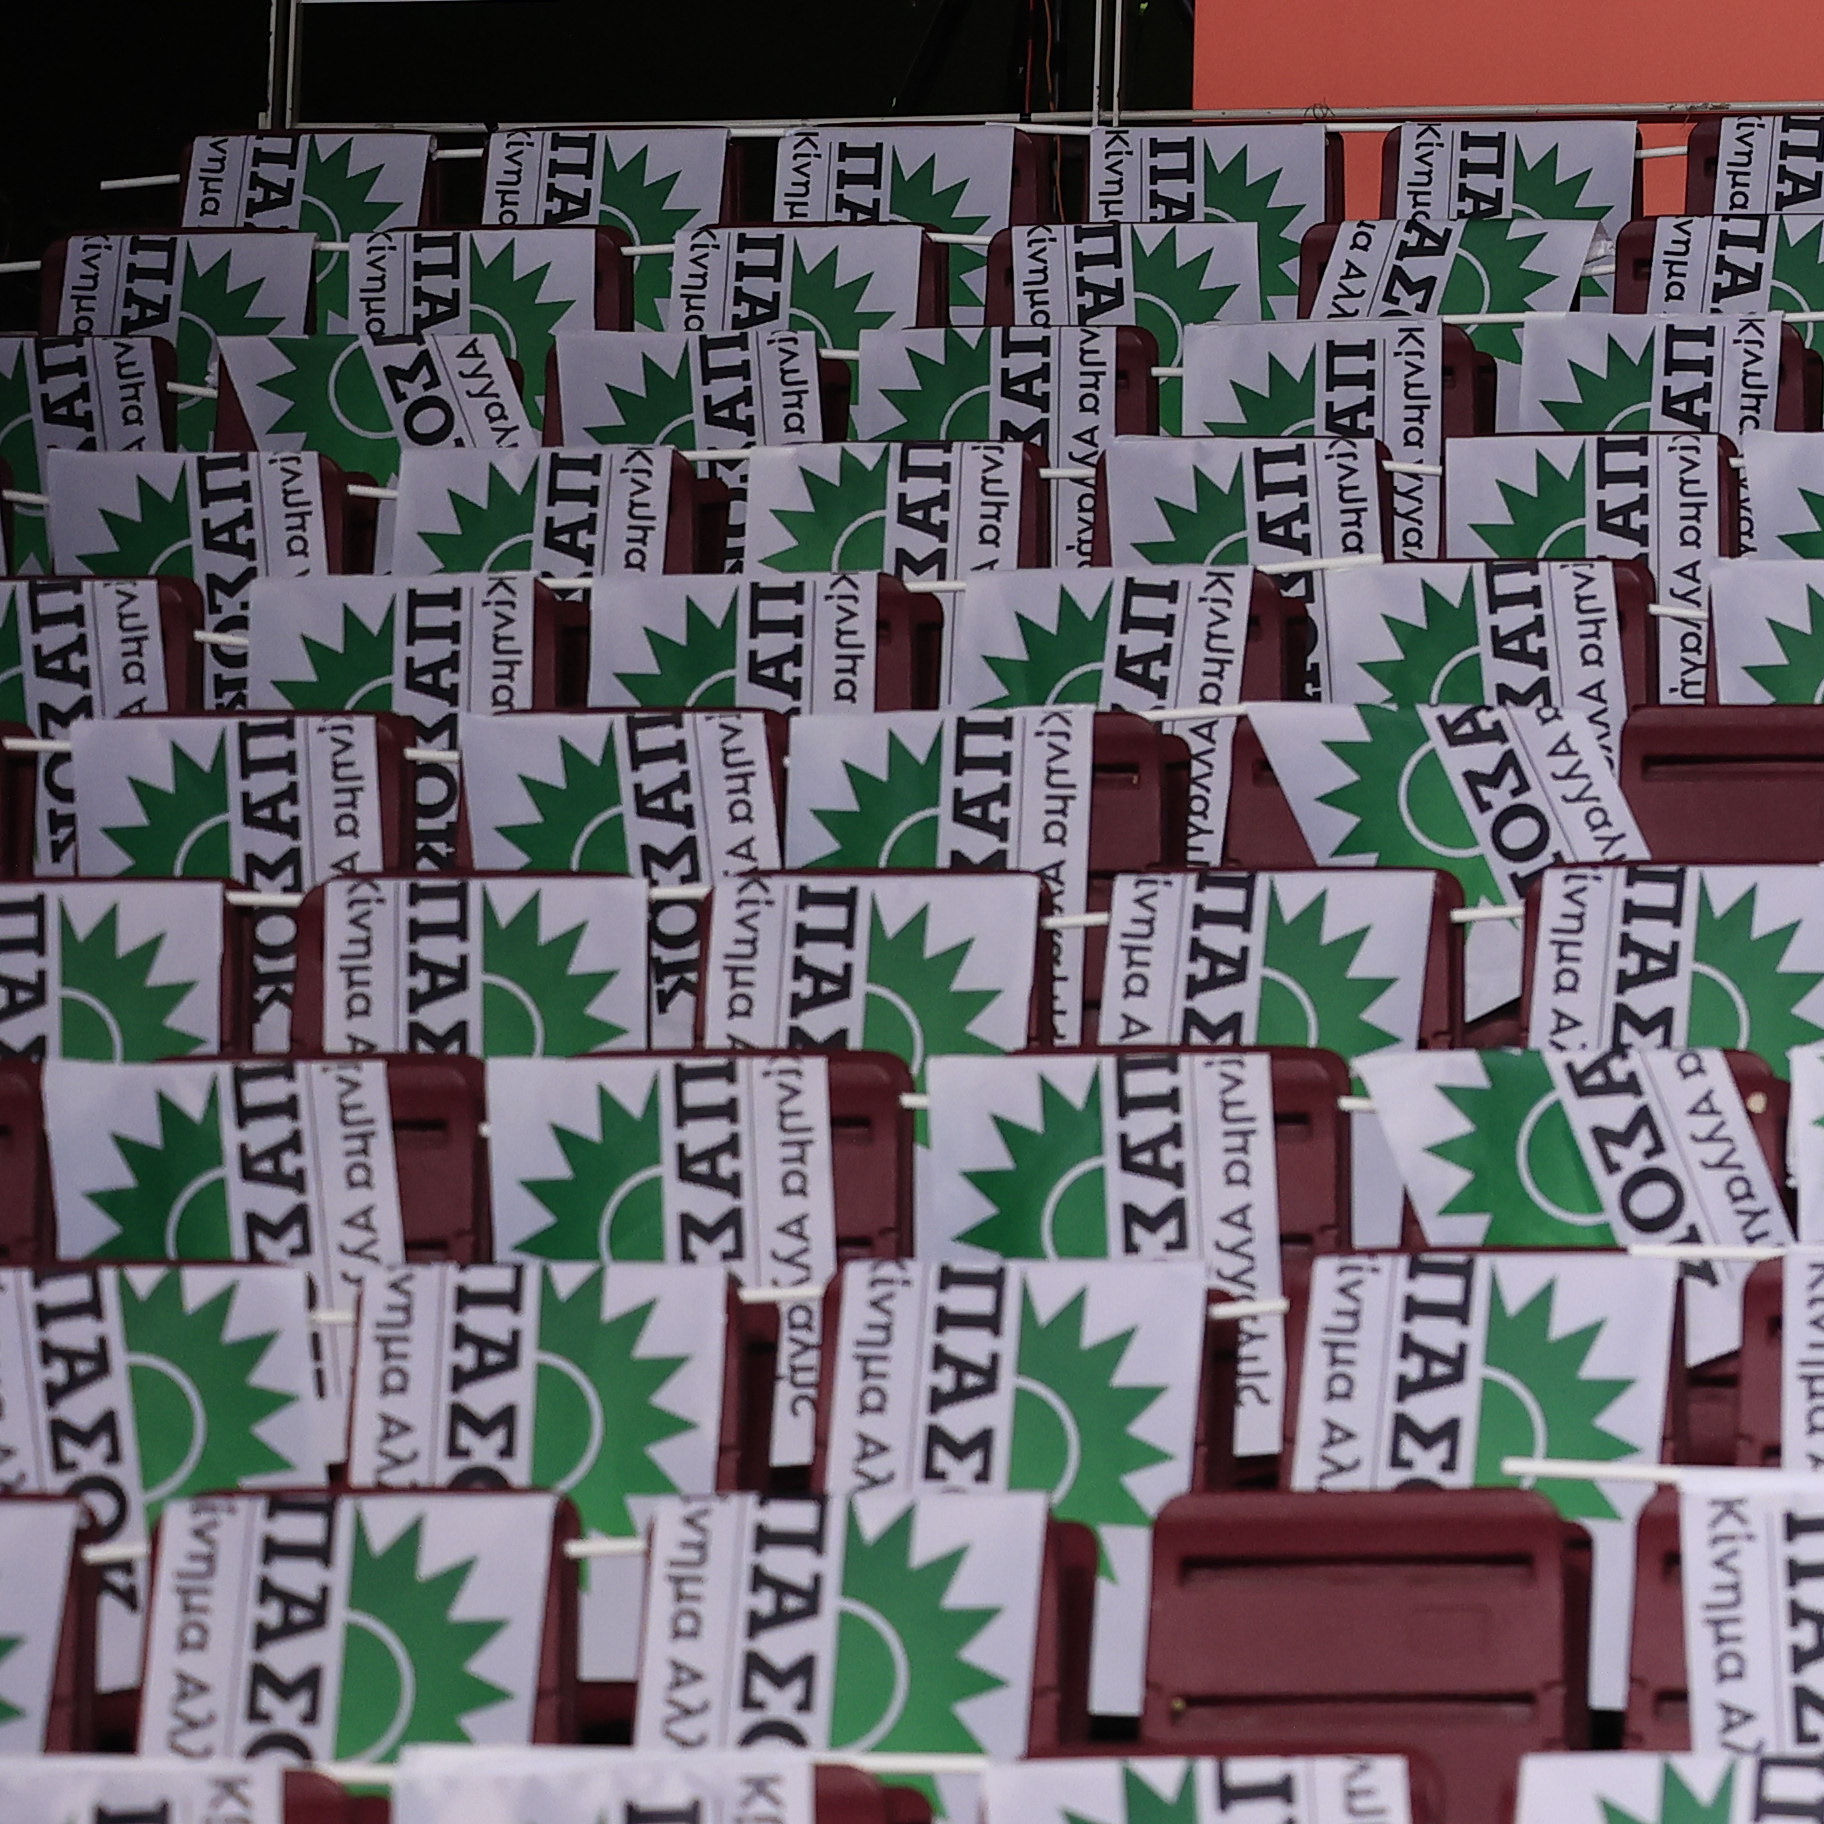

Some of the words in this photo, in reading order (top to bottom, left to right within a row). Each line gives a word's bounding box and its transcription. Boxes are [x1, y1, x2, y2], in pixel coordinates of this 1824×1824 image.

[784, 132, 821, 219] Κίνημ
[1099, 130, 1133, 218] Κίνημ
[409, 878, 469, 1054] ΠΑΣ
[1120, 875, 1158, 999] ίνημα
[1186, 874, 1248, 1045] ΠΑΣ
[1550, 867, 1588, 994] ίνημα
[1611, 867, 1679, 1051] ΠΑΣ
[924, 1265, 1005, 1482] ΠΑΣ
[1322, 1257, 1380, 1402] ίνημα
[1391, 1255, 1466, 1471] ΠΑΣ
[1702, 1498, 1755, 1684] Κίνημα
